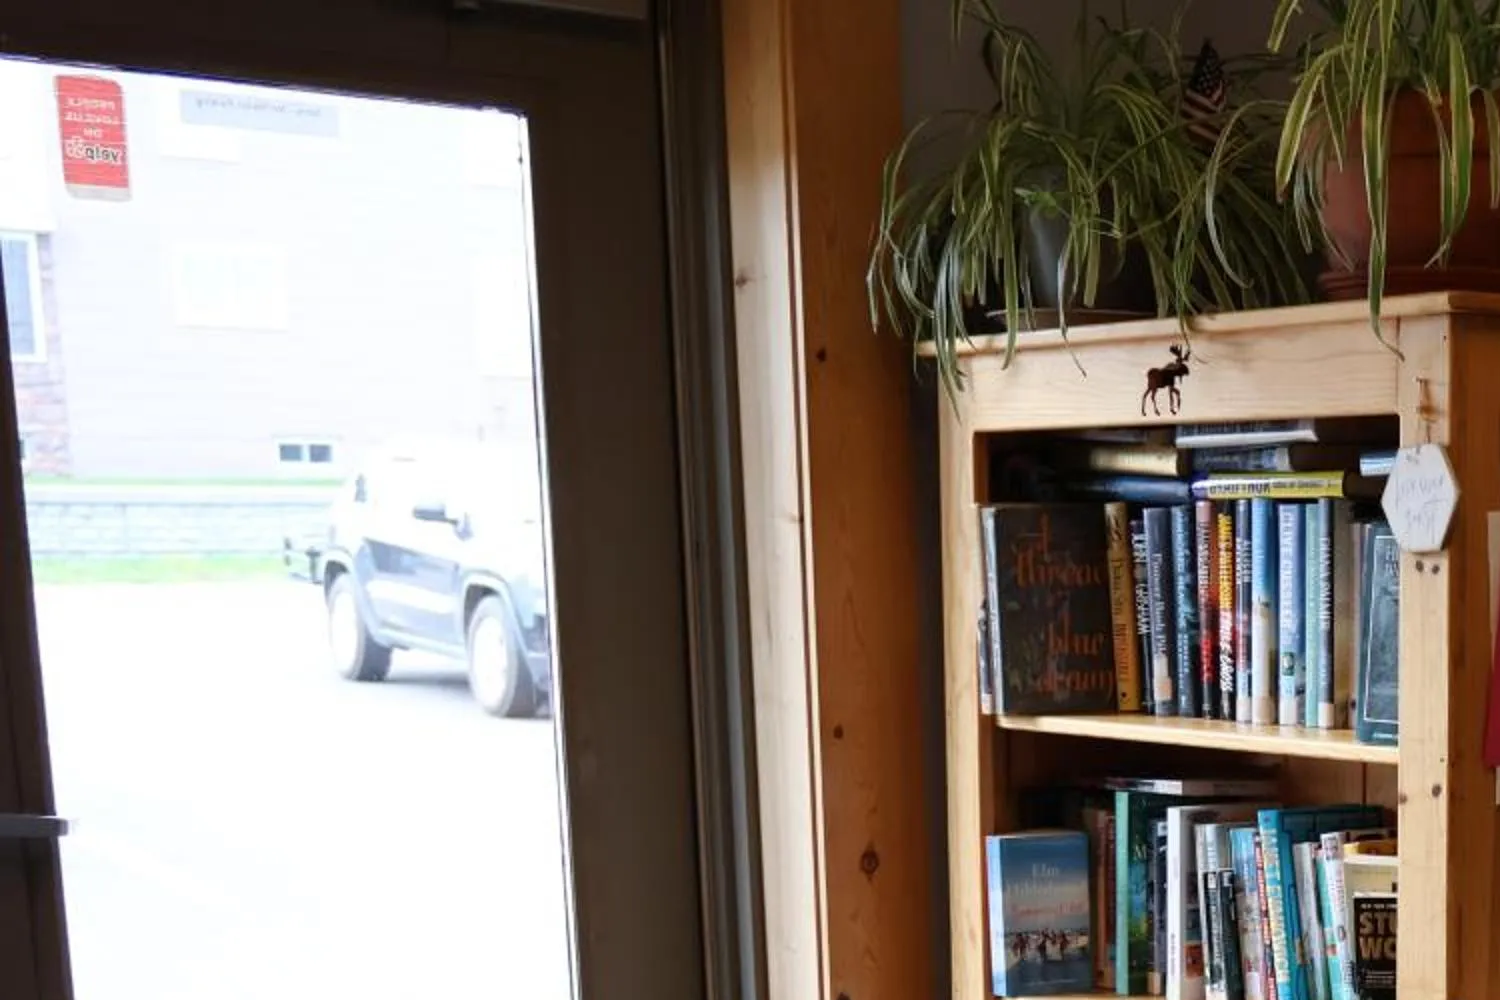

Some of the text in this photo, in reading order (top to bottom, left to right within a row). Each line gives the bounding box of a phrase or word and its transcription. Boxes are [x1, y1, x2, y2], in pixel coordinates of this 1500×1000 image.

[1218, 513, 1232, 548] JAMES
[1131, 533, 1151, 636] JOHN GRISHAM
[1218, 551, 1233, 609] PATTERSON
[1281, 512, 1297, 632] CLIVE CUSSLER
[1319, 537, 1331, 632] DIANA PALMER
[1220, 655, 1234, 693] CROSS
[1264, 828, 1280, 880] JANET
[1269, 885, 1291, 983] EVANOVICH
